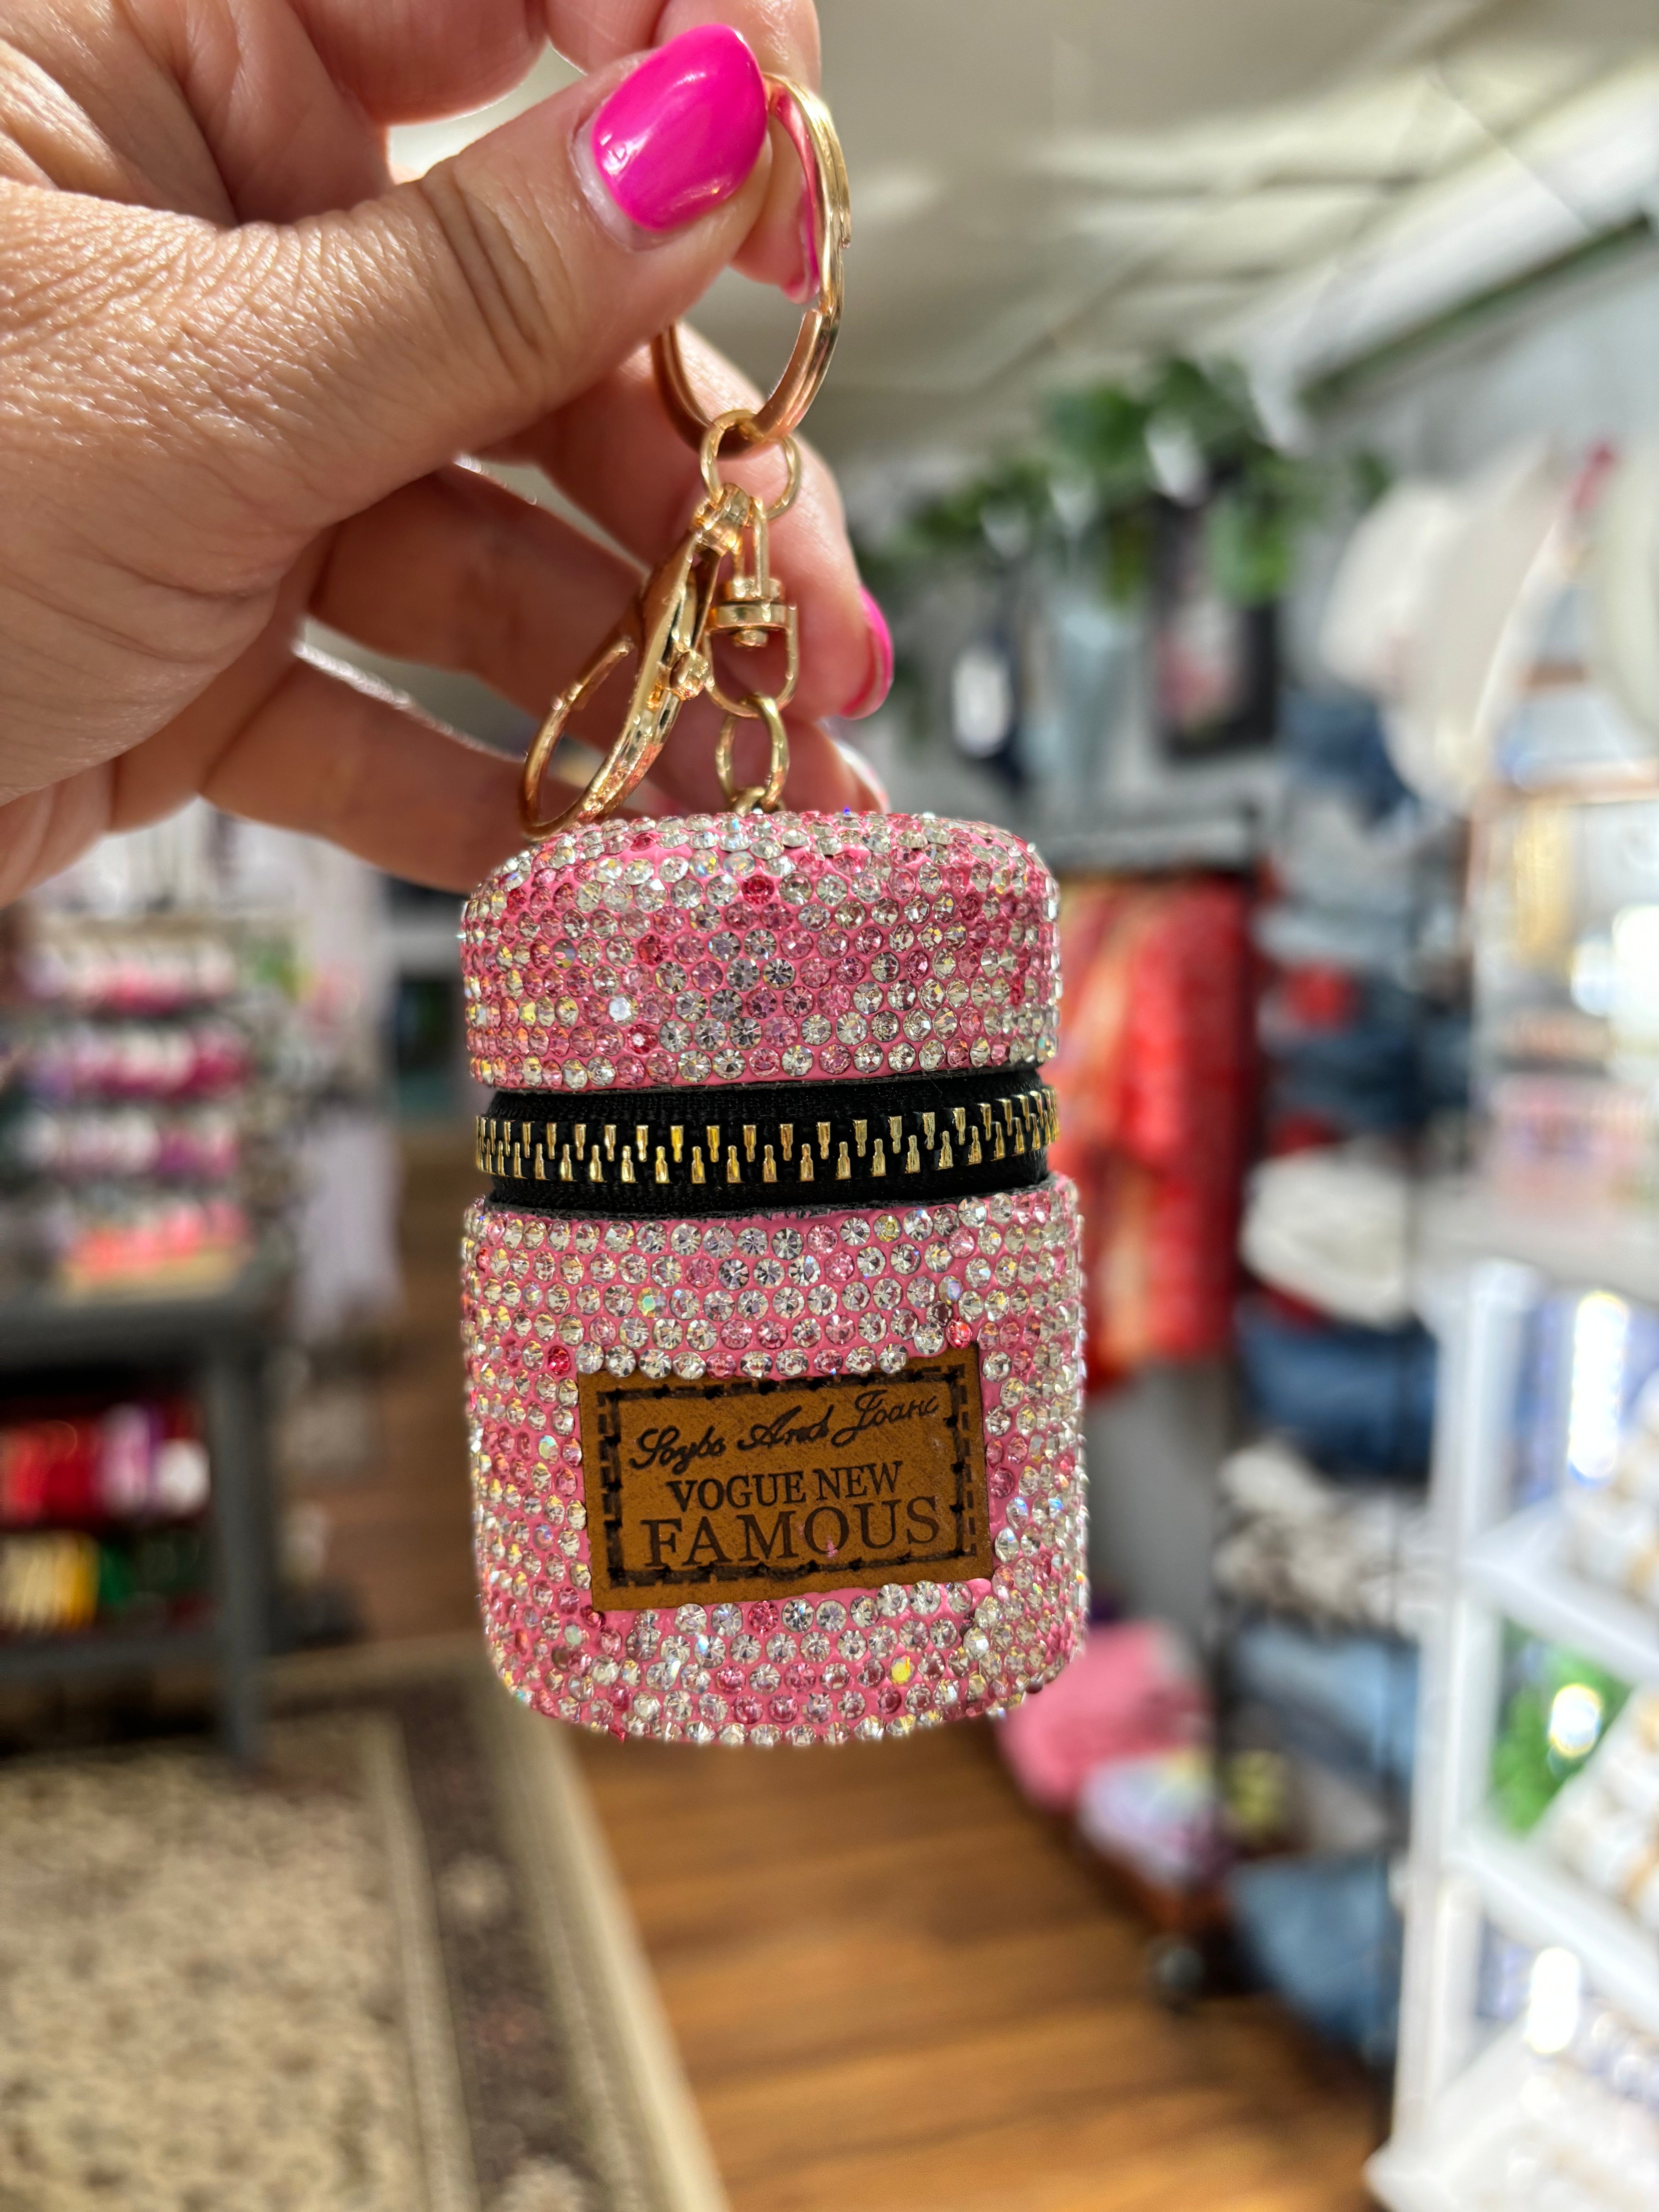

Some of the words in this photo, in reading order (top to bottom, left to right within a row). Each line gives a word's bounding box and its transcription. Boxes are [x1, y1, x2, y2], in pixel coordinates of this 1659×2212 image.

[737, 1405, 835, 1451] And
[667, 1470, 807, 1512] VOGUE
[816, 1460, 903, 1501] NEW
[640, 1496, 941, 1567] FAMOUS
